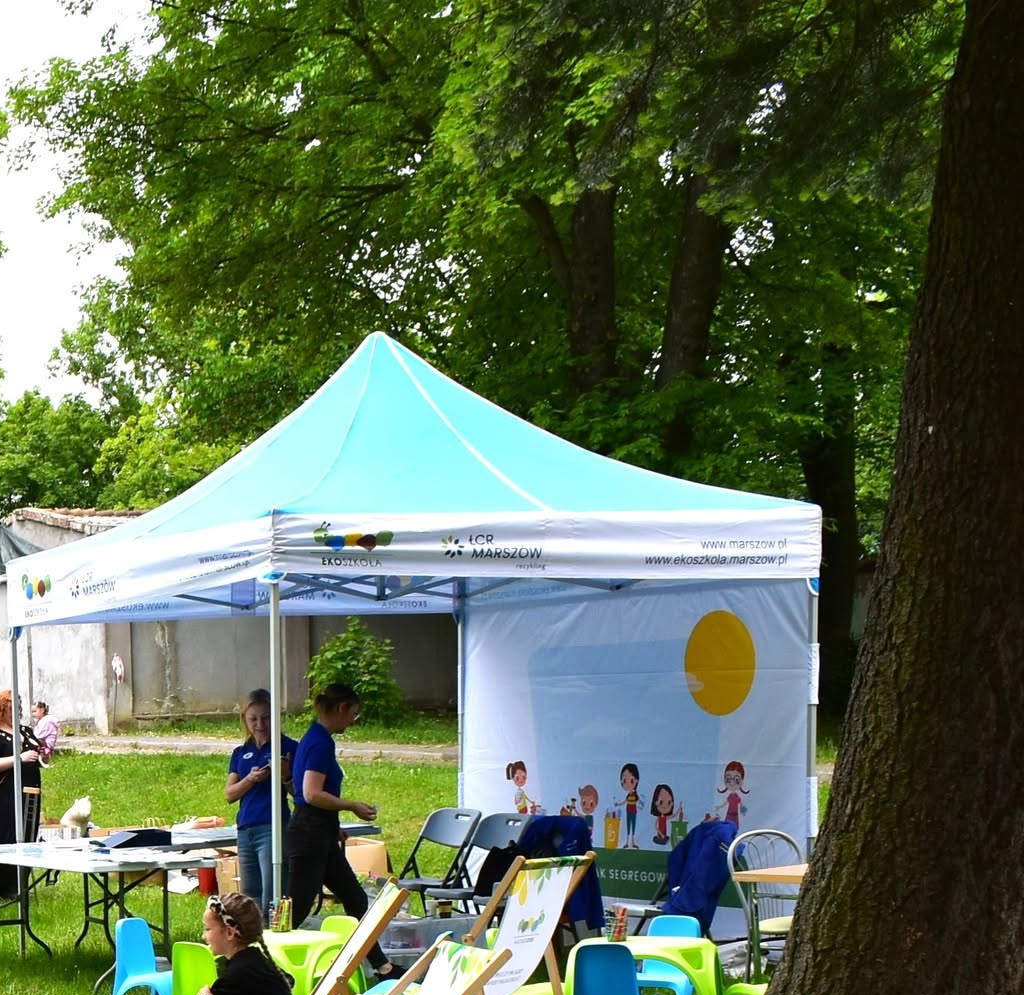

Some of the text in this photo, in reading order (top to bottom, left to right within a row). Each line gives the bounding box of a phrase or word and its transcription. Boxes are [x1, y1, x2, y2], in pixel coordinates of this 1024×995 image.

[468, 534, 494, 545] ŁCR
[700, 538, 787, 551] www.marszow.pl
[471, 545, 542, 559] MARSZÓW
[321, 557, 383, 567] EKOSZKOŁA
[645, 553, 788, 567] www.ekoszkola.marszow.pl
[608, 868, 666, 882] SEGREGOW
